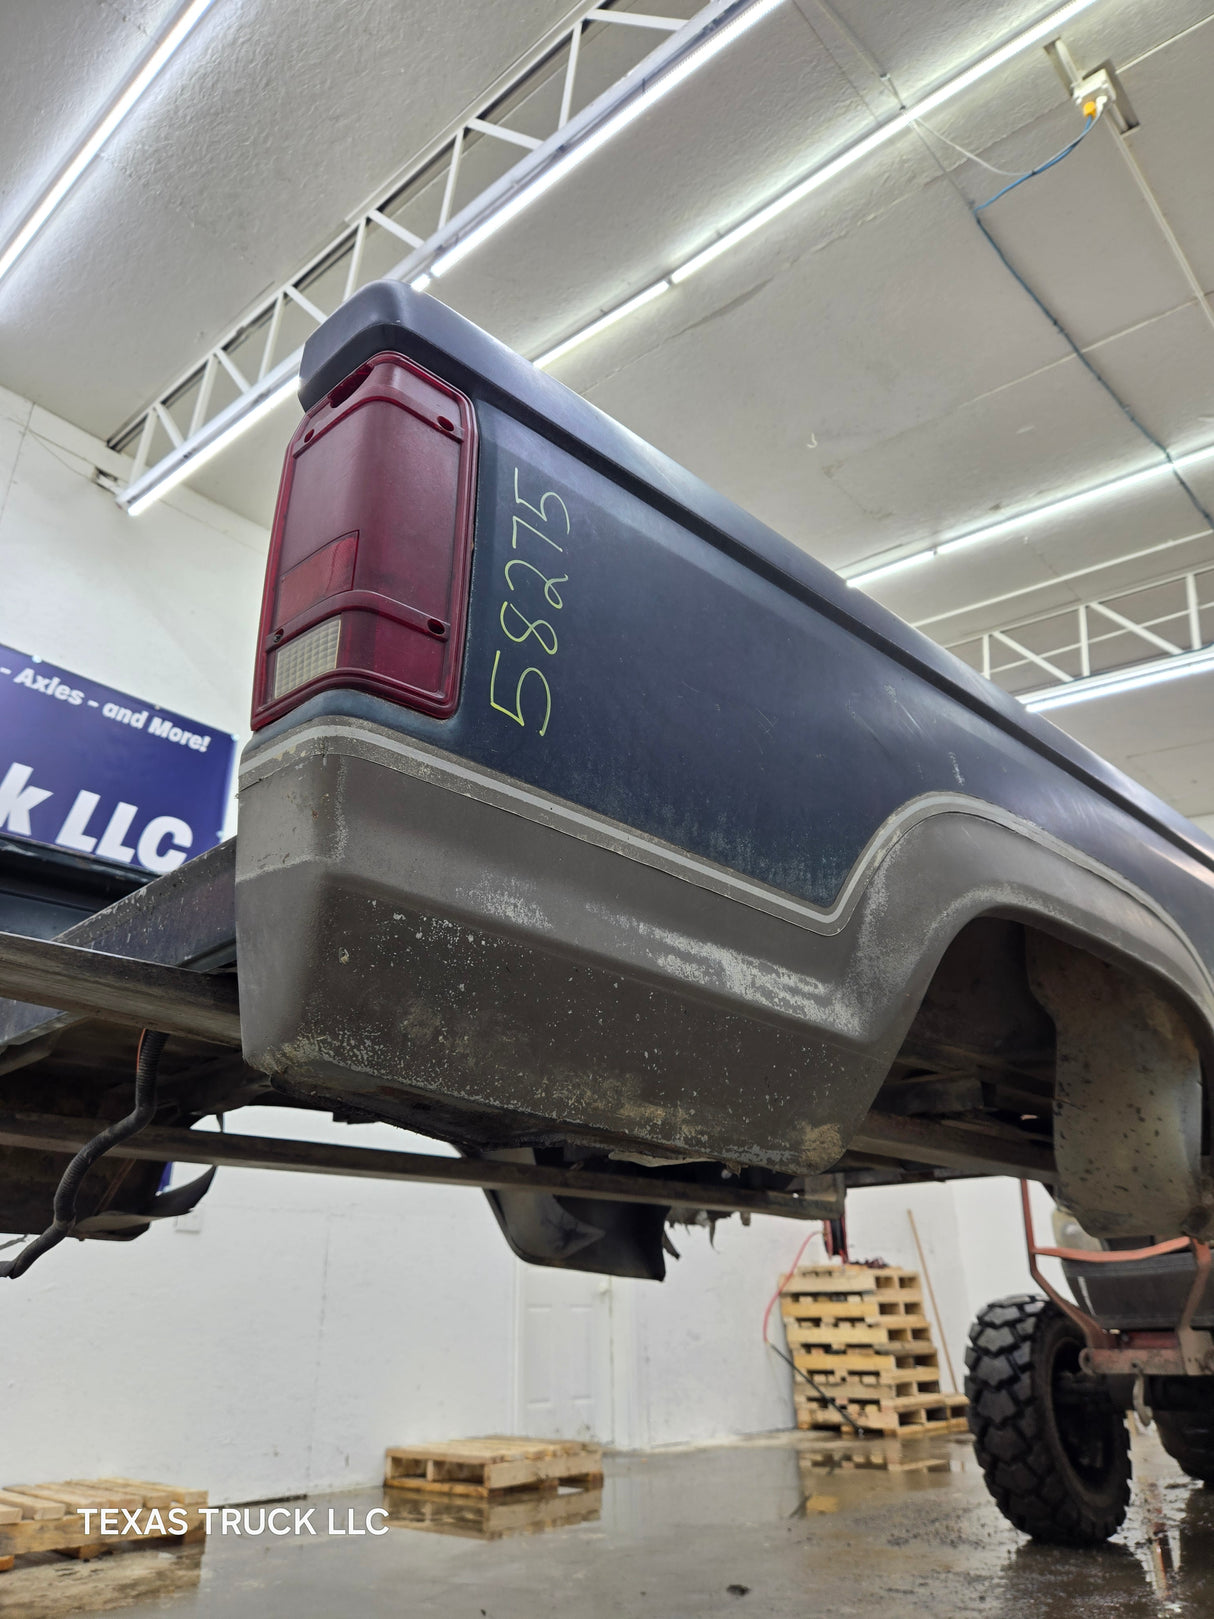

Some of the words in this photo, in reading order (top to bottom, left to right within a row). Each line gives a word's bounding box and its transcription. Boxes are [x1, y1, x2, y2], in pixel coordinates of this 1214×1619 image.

[490, 466, 570, 736] 58275
[13, 667, 85, 706] Axles
[102, 701, 149, 729] and
[148, 716, 211, 752] More!
[55, 789, 194, 874] LLC
